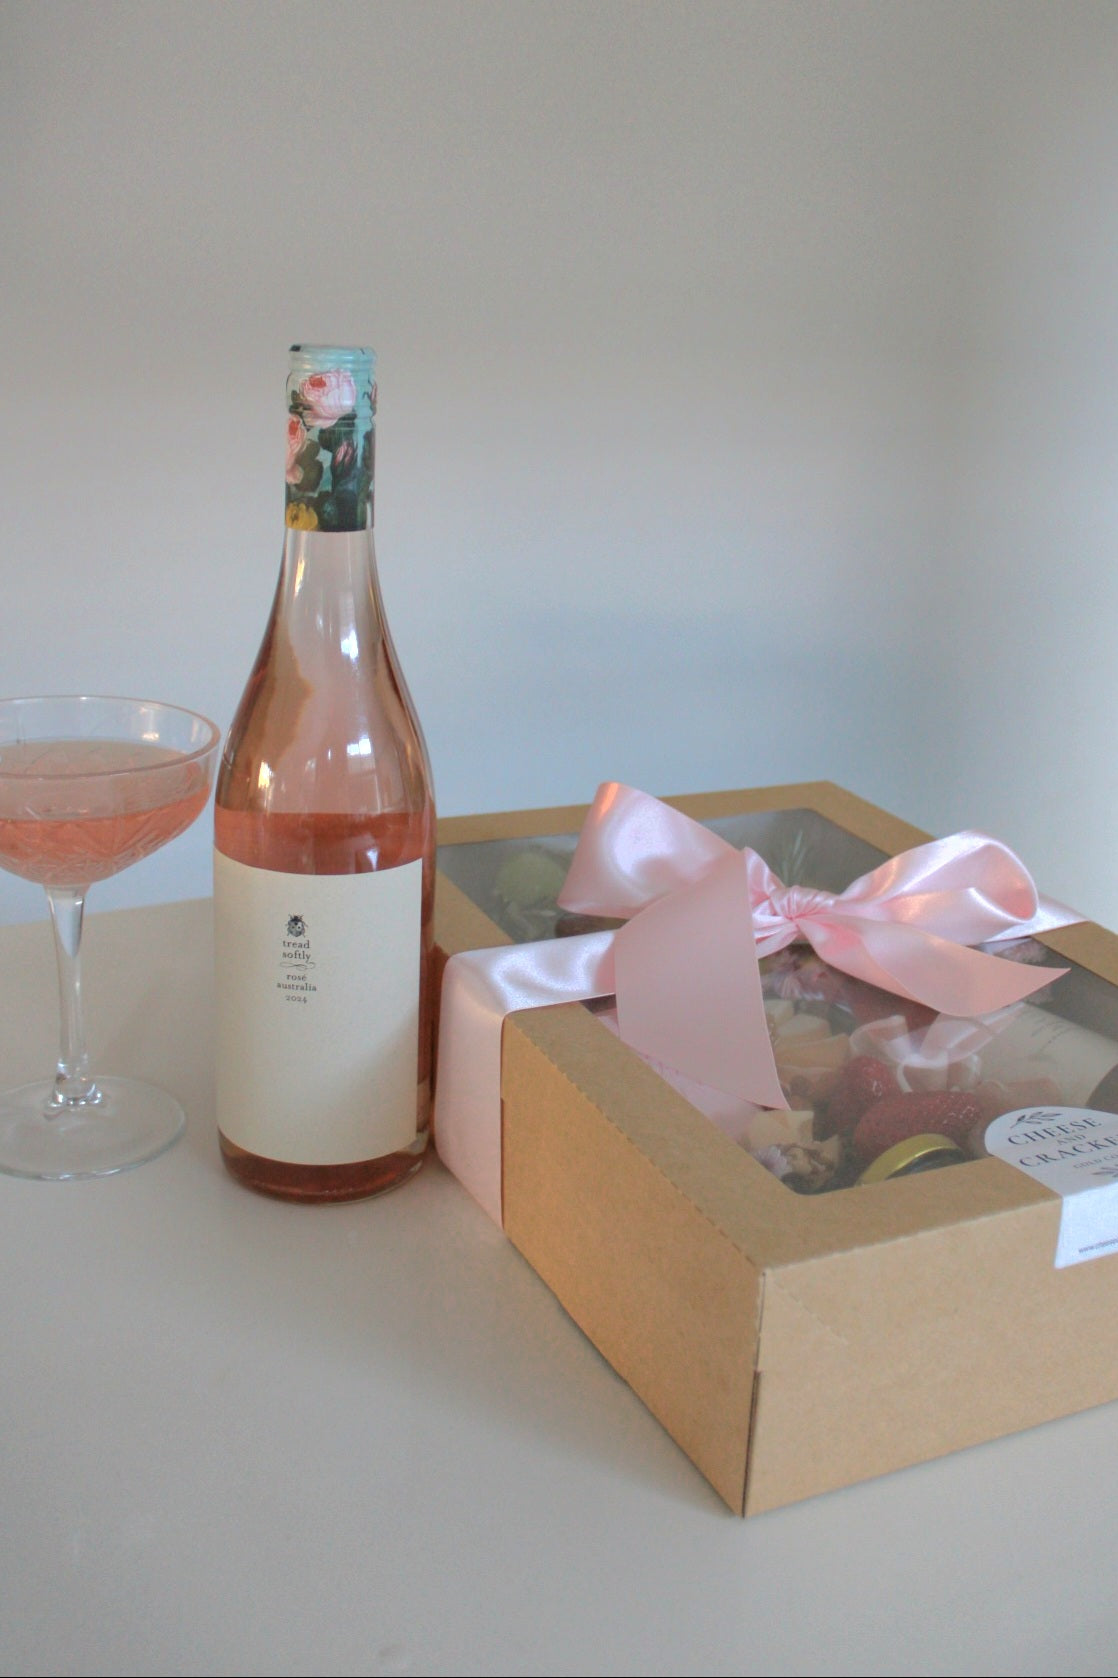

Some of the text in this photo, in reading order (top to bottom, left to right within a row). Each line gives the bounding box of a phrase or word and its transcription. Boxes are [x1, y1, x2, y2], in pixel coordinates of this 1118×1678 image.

[282, 939, 310, 949] tread
[282, 950, 311, 963] softly
[286, 973, 308, 982] rosé
[276, 982, 317, 992] australia
[285, 994, 308, 1004] 2024
[1007, 1117, 1102, 1147] CHEESE
[1057, 1133, 1087, 1146] AND
[1073, 1158, 1103, 1169] GOLD
